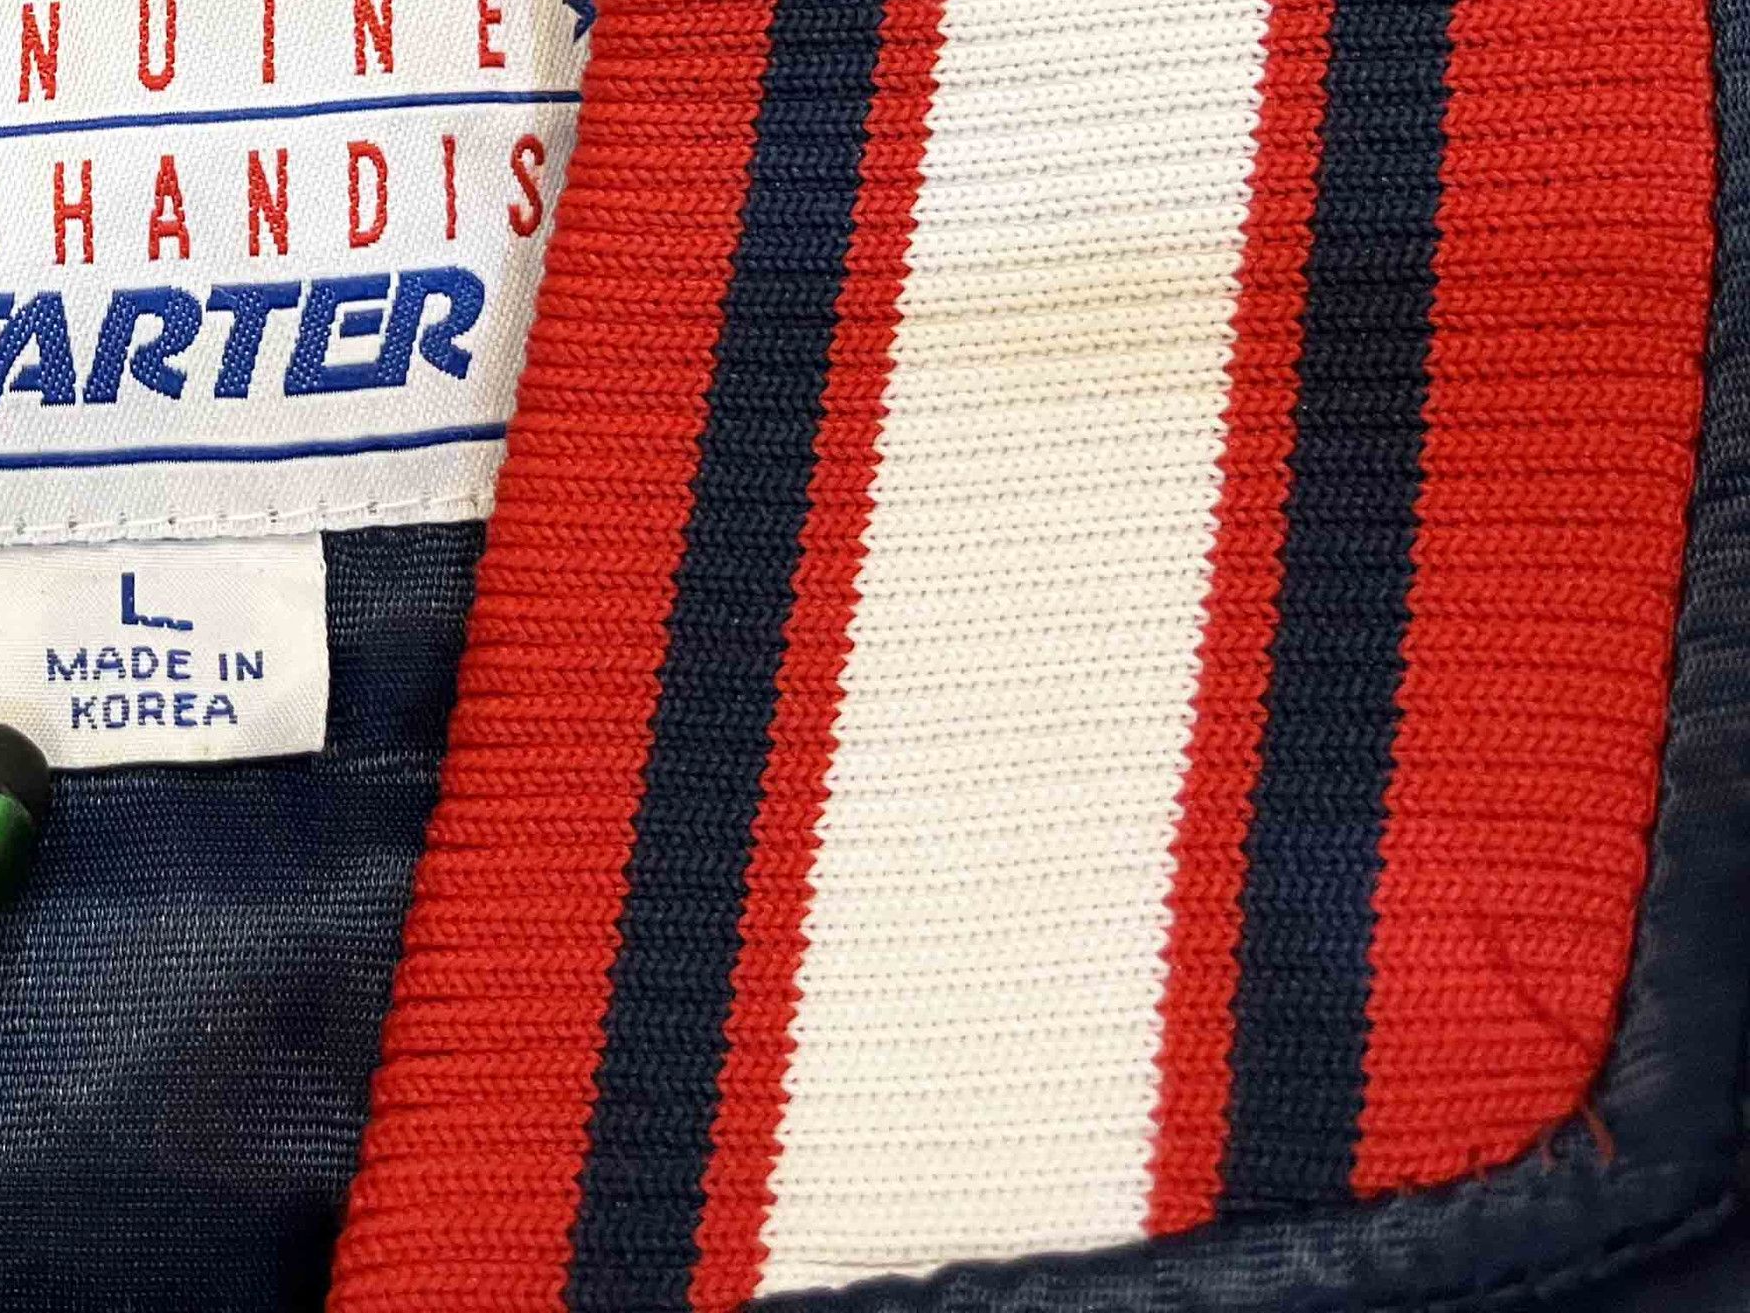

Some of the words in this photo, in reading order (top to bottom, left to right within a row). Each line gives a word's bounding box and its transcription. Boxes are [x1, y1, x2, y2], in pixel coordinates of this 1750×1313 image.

[121, 572, 193, 631] L
[46, 646, 193, 681] MADE
[218, 650, 264, 681] IN
[71, 693, 238, 729] KOREA
